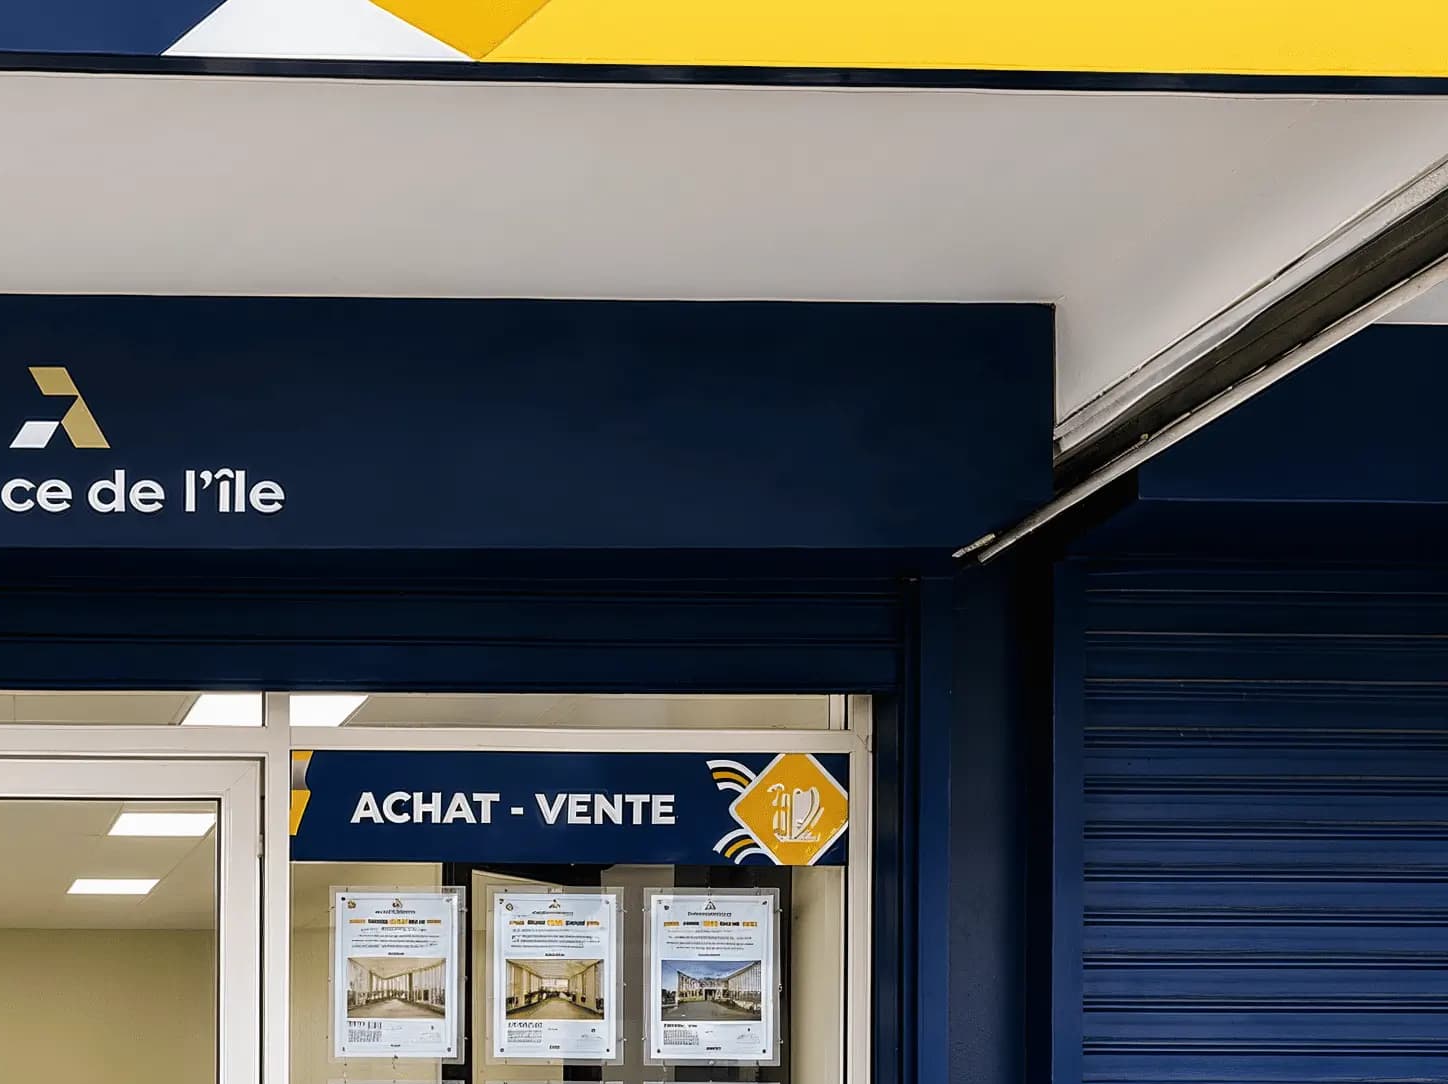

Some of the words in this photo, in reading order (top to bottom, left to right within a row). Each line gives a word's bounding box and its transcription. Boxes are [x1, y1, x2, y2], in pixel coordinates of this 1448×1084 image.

[87, 469, 165, 513] de
[350, 791, 501, 825] ACHAT
[534, 793, 676, 826] VENTE
